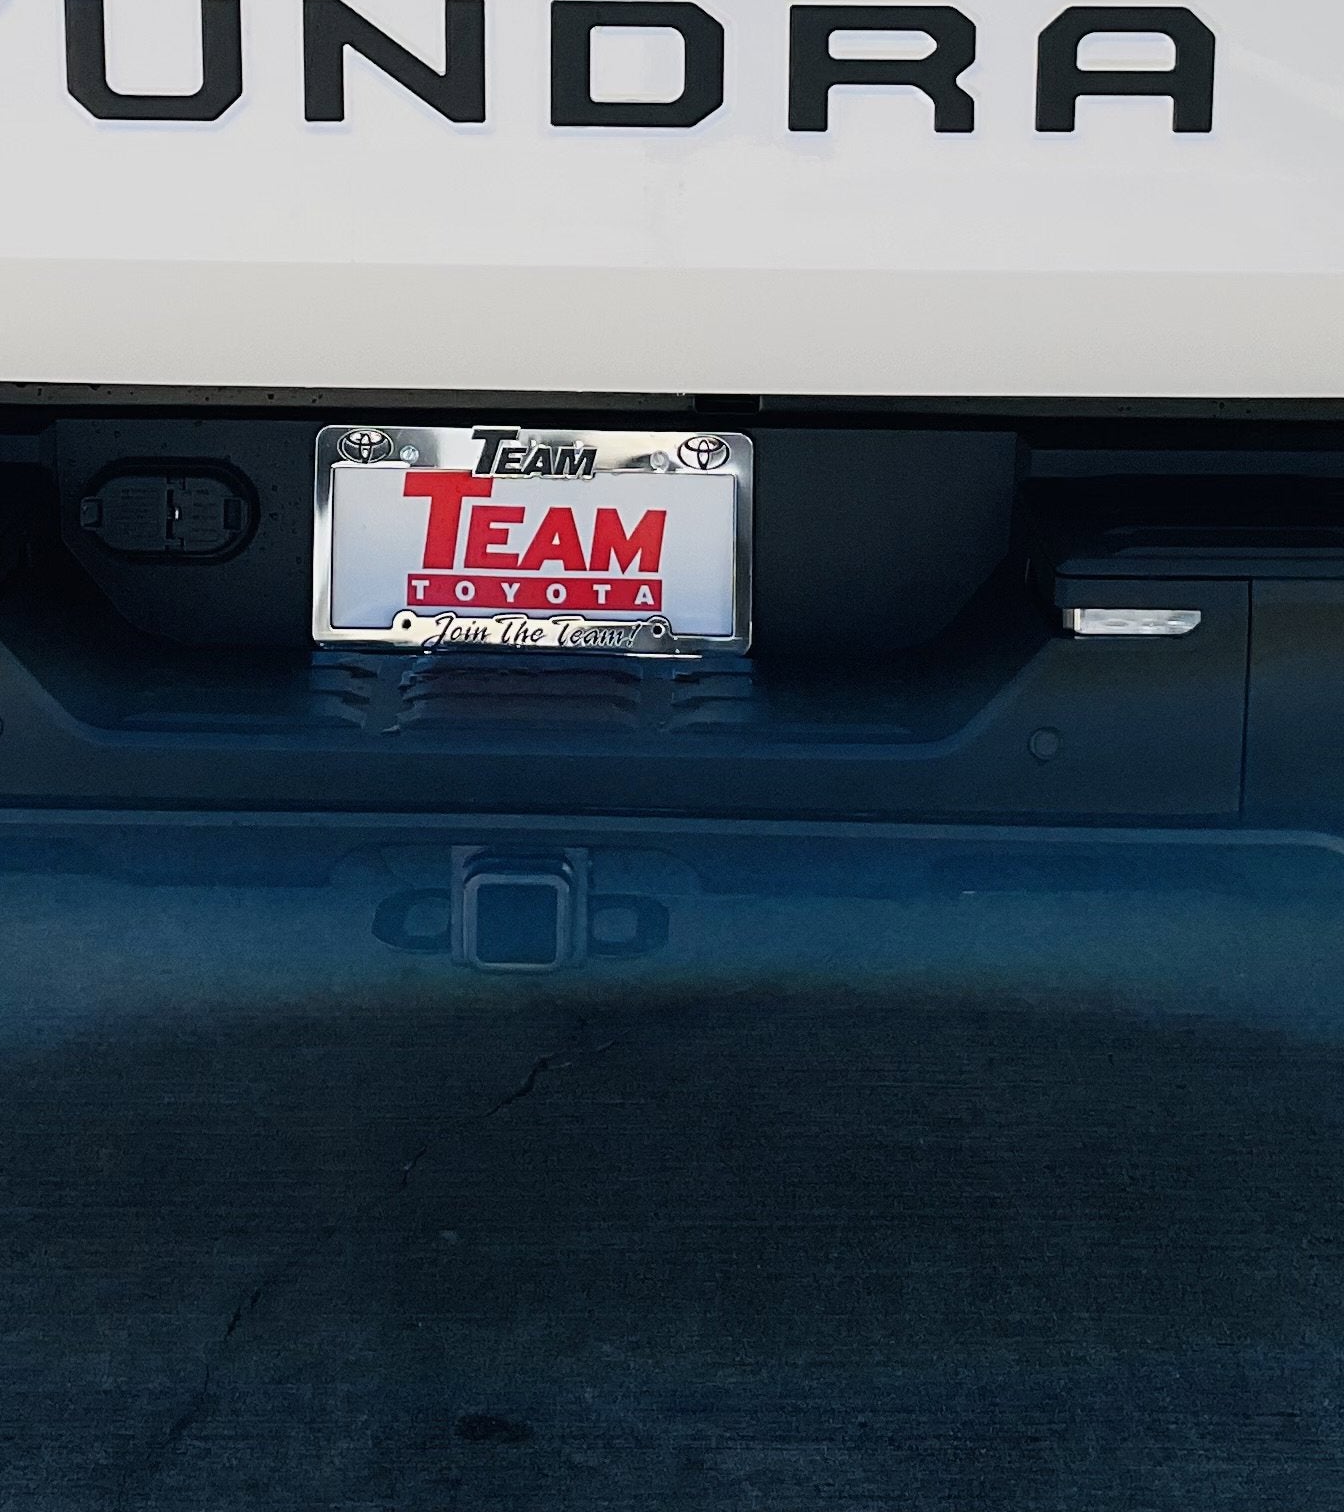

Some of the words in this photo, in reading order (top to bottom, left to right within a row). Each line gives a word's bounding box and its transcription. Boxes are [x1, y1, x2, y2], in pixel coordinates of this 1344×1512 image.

[472, 427, 597, 479] TEAM
[403, 471, 668, 575] TEAM
[411, 578, 656, 606] TOYOTA
[421, 615, 491, 647] Join
[494, 616, 546, 645] The
[551, 618, 642, 647] Team!
